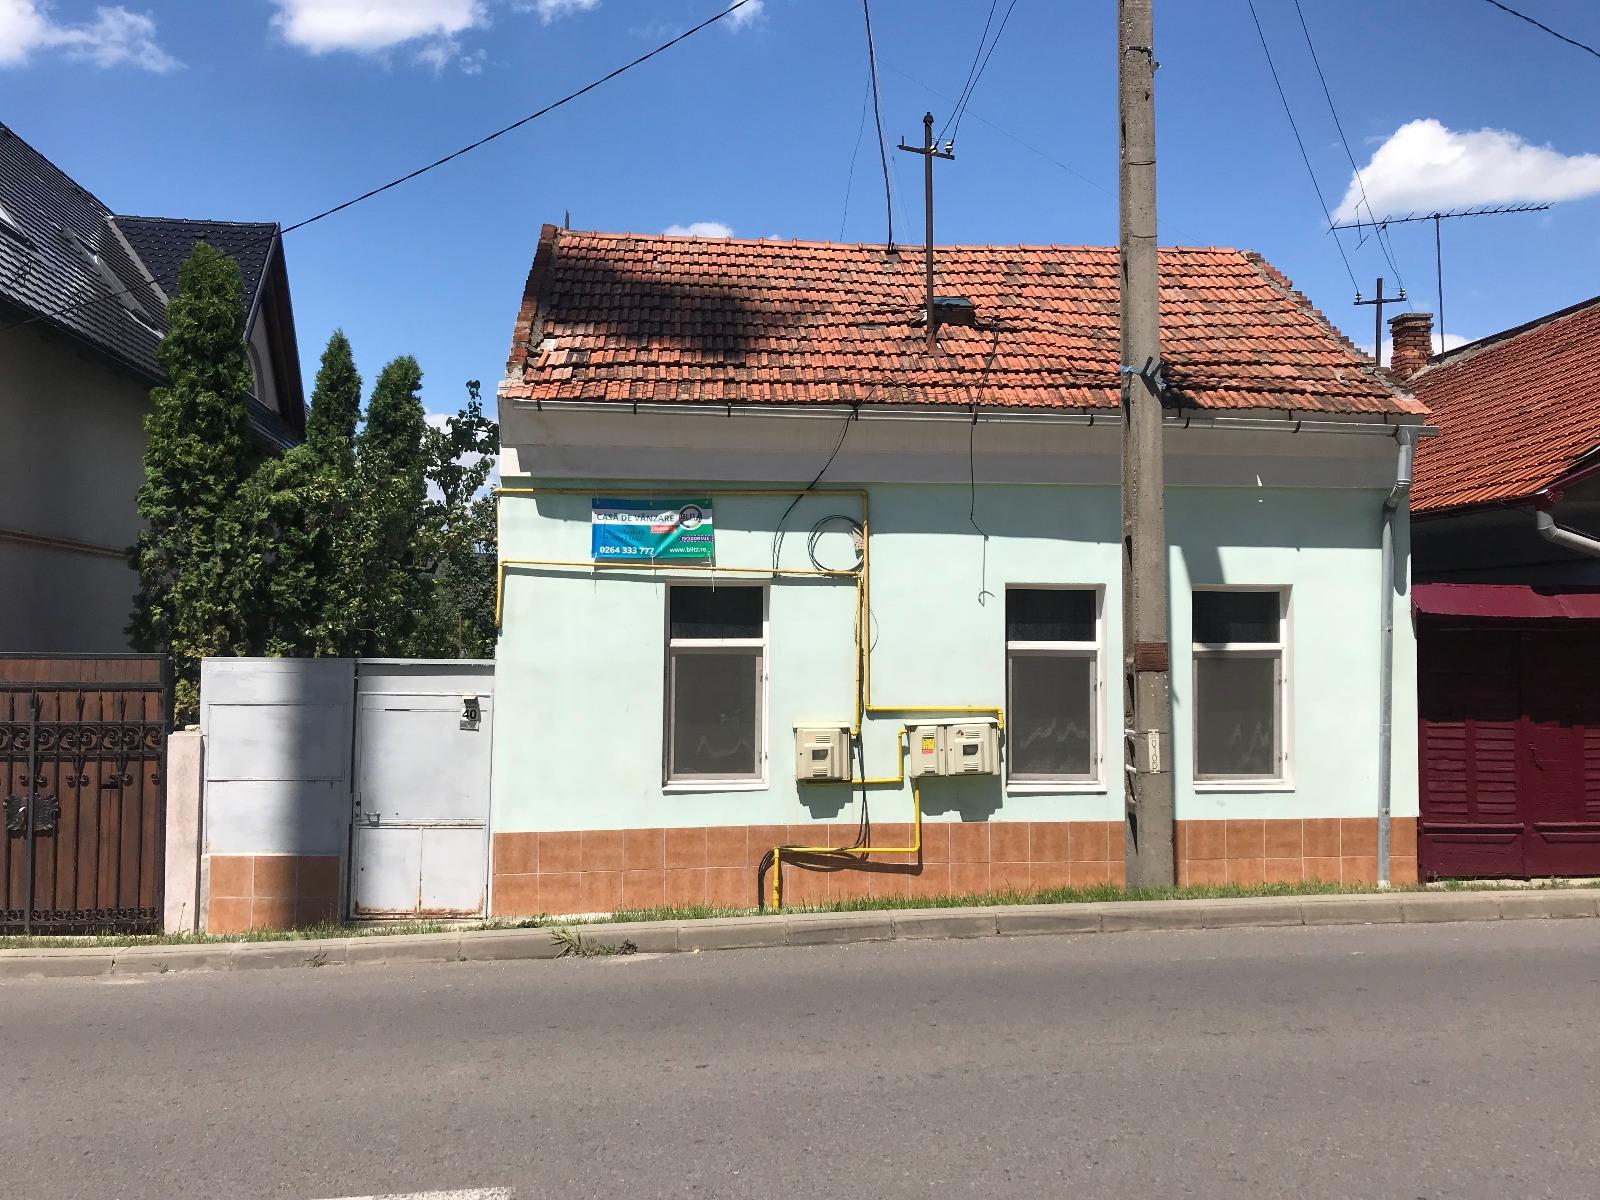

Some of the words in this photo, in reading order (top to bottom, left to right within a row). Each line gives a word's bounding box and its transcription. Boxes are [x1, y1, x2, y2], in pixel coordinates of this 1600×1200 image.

[600, 546, 620, 554] 0264
[622, 546, 637, 554] 333
[639, 547, 655, 555] 777
[461, 709, 477, 719] 40
